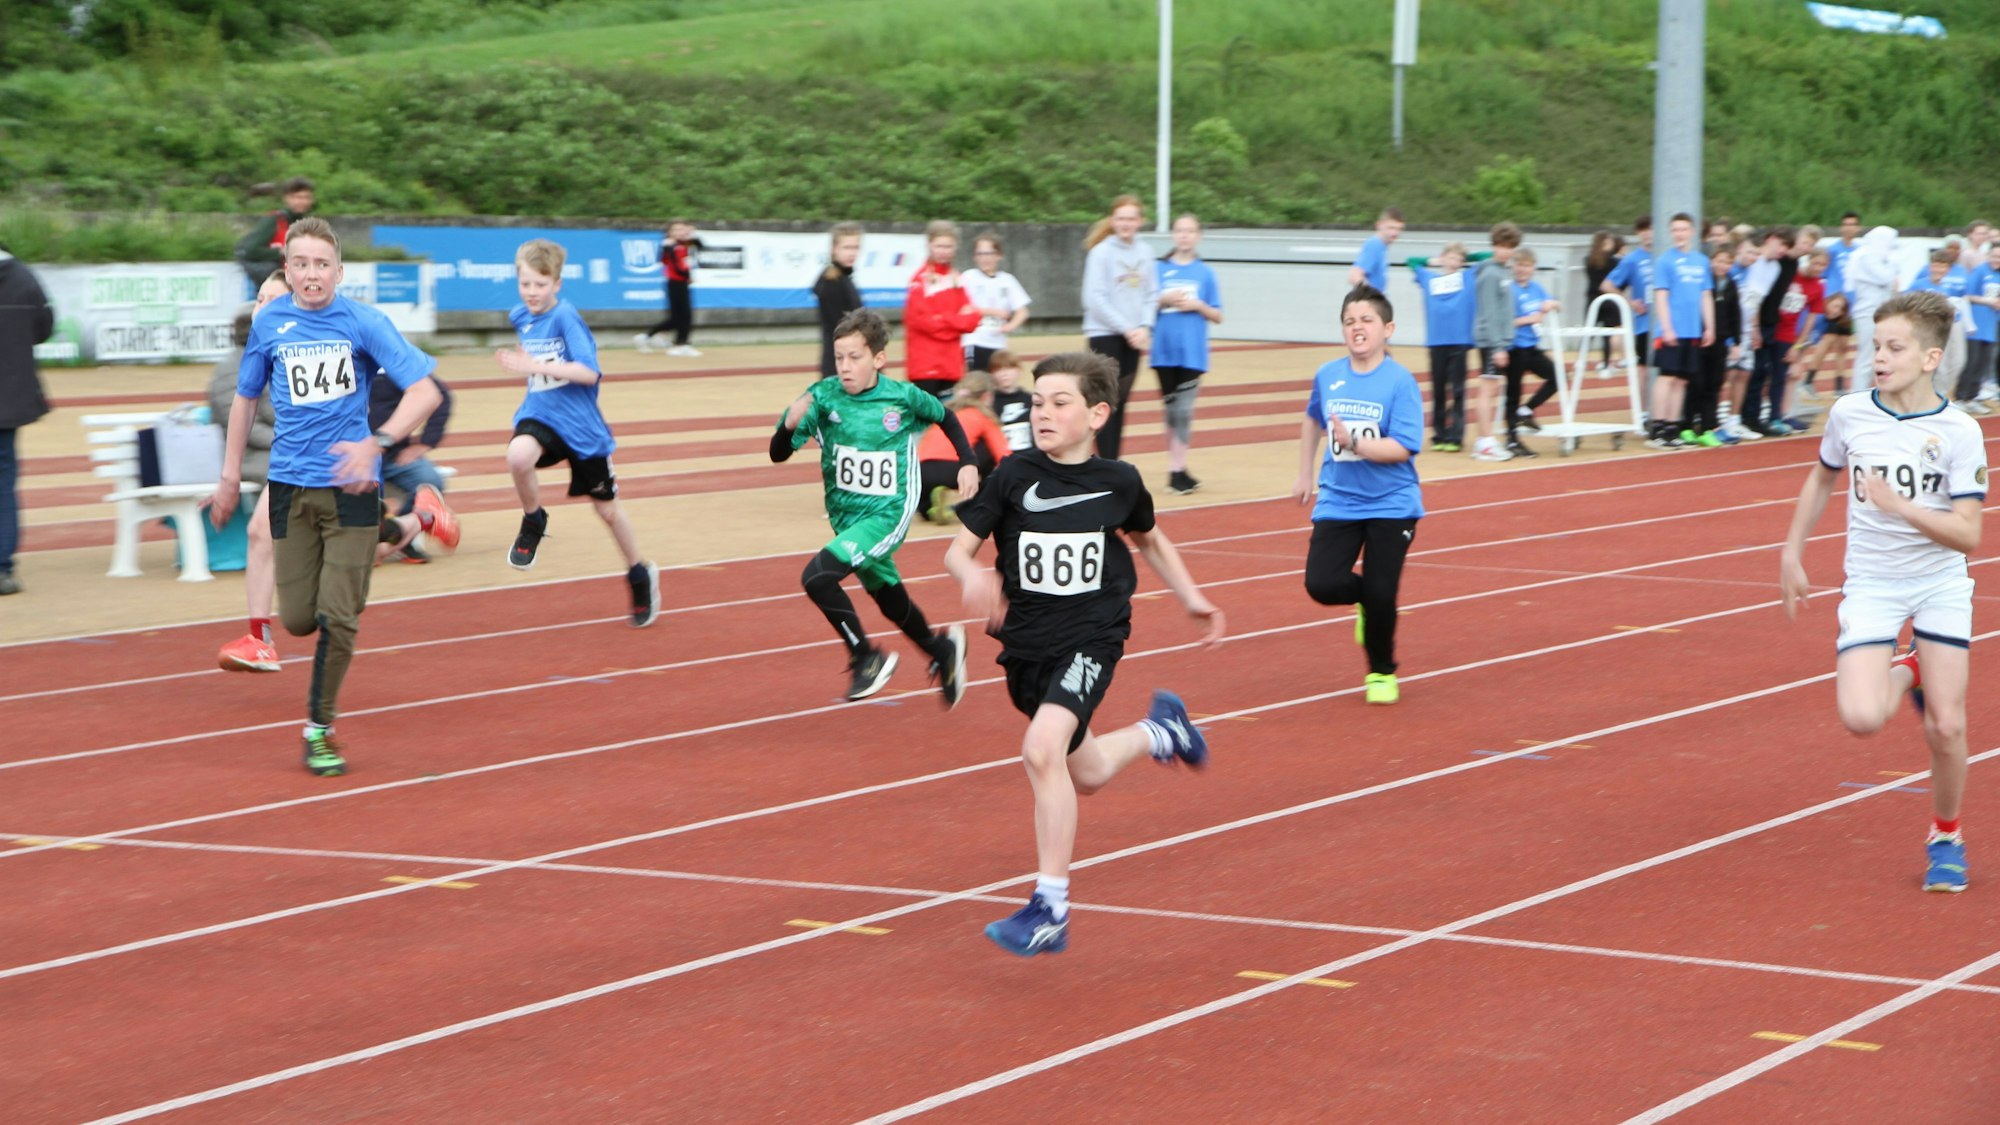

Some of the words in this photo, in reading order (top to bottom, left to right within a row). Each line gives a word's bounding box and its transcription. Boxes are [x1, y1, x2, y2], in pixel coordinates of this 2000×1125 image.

[168, 275, 213, 302] SPORT
[291, 357, 351, 397] 644
[1328, 402, 1380, 418] Talentiade
[840, 457, 893, 488] 696
[1024, 542, 1100, 587] 866
